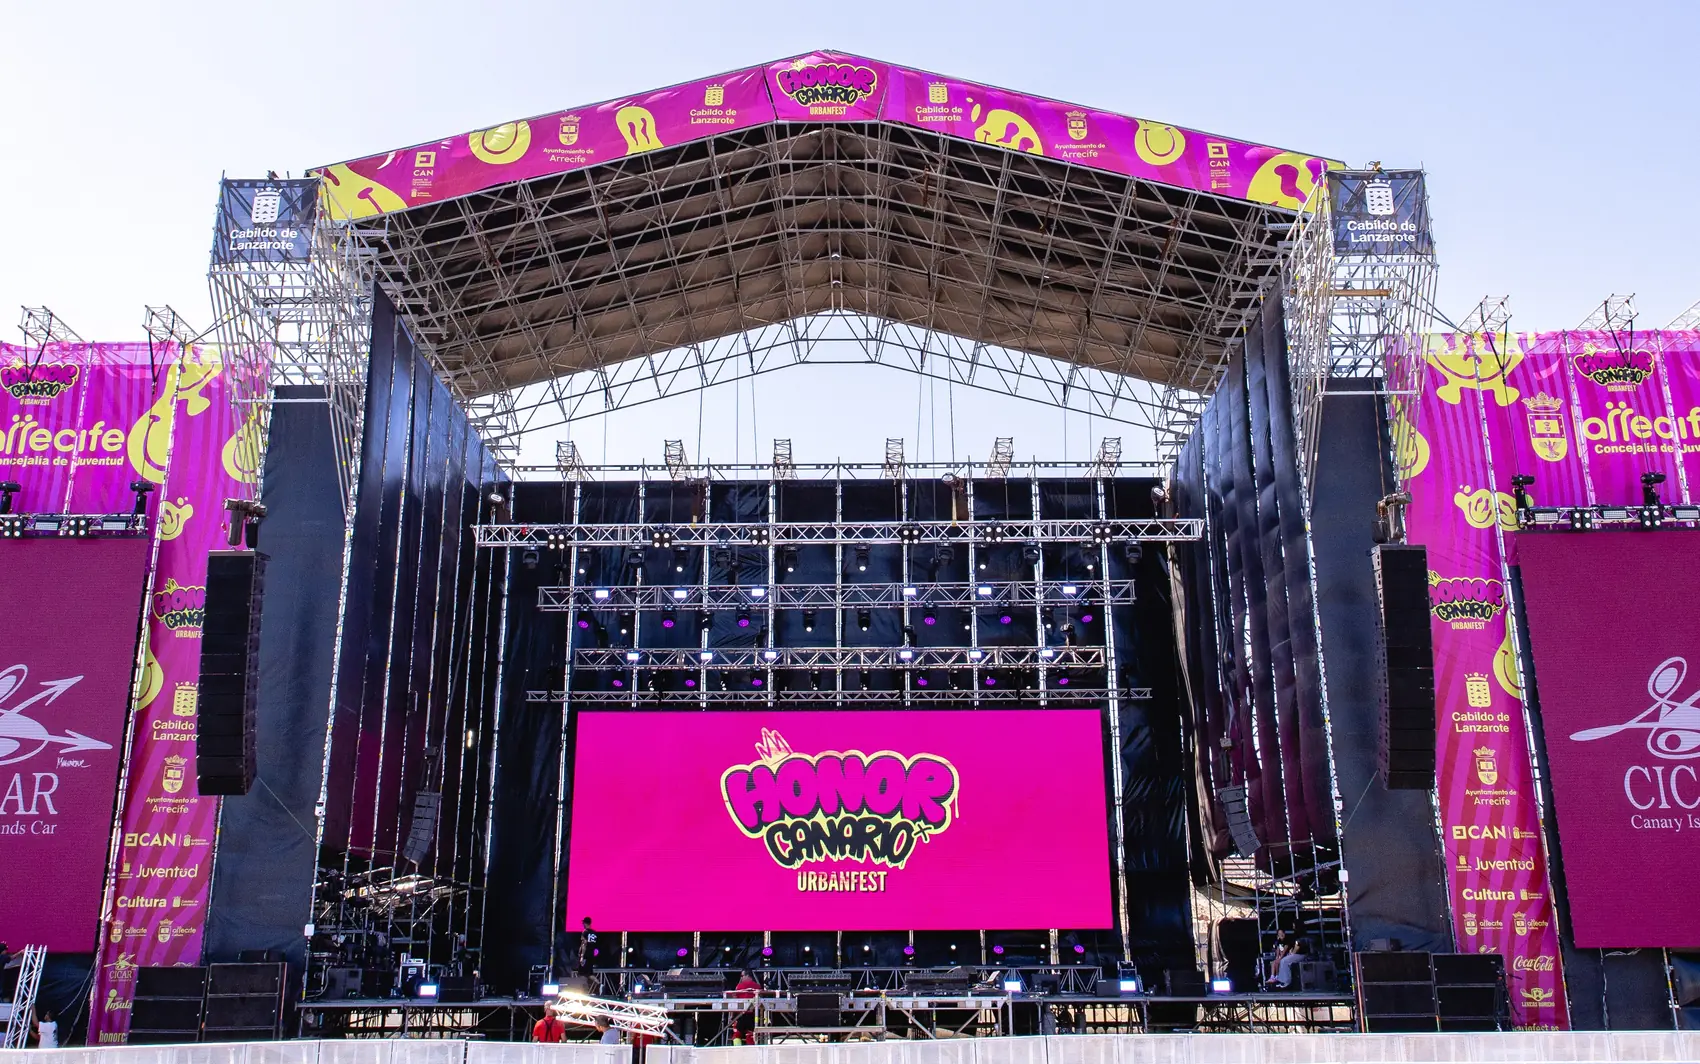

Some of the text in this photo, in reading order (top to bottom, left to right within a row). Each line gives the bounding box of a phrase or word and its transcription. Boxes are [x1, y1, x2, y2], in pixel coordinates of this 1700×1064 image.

[778, 64, 877, 93] HONOR
[795, 87, 859, 106] CANARIO
[690, 109, 723, 117] Cabildo
[810, 106, 847, 115] URBANFEST
[917, 114, 962, 122] Lanzarote
[549, 155, 586, 163] Arrecife
[1062, 150, 1098, 158] Arrecife
[413, 169, 434, 177] CAN
[1347, 220, 1416, 231] Cabildo de
[230, 228, 298, 239] Cabildo de
[1351, 233, 1416, 243] Lanzarote
[229, 240, 294, 250] Lanzarote
[1593, 369, 1643, 385] CANARIO
[11, 383, 61, 398] CANARIO
[0, 414, 125, 455] rrecife
[1594, 443, 1657, 454] Concejalía
[1660, 443, 1674, 453] de
[53, 457, 68, 465] de
[75, 456, 124, 466] Juventud
[1436, 603, 1493, 621] CANARIO
[1451, 622, 1485, 630] URBANFEST
[1452, 712, 1510, 722] Cabildo de
[152, 720, 195, 730] Cabildo
[1455, 723, 1510, 733] Lanzarote
[722, 752, 958, 836] HONOR
[146, 796, 189, 804] Ayuntamiento
[1474, 797, 1510, 806] Arrecife
[152, 805, 189, 814] Arrecife
[31, 820, 57, 835] Car
[1631, 814, 1683, 832] Canary
[765, 817, 916, 868] CANARIO
[797, 871, 888, 892] URBANFEST
[1462, 888, 1516, 901] Cultura
[117, 896, 167, 908] Cultura
[1513, 955, 1555, 972] Coca-Cola
[109, 970, 132, 979] CICAR
